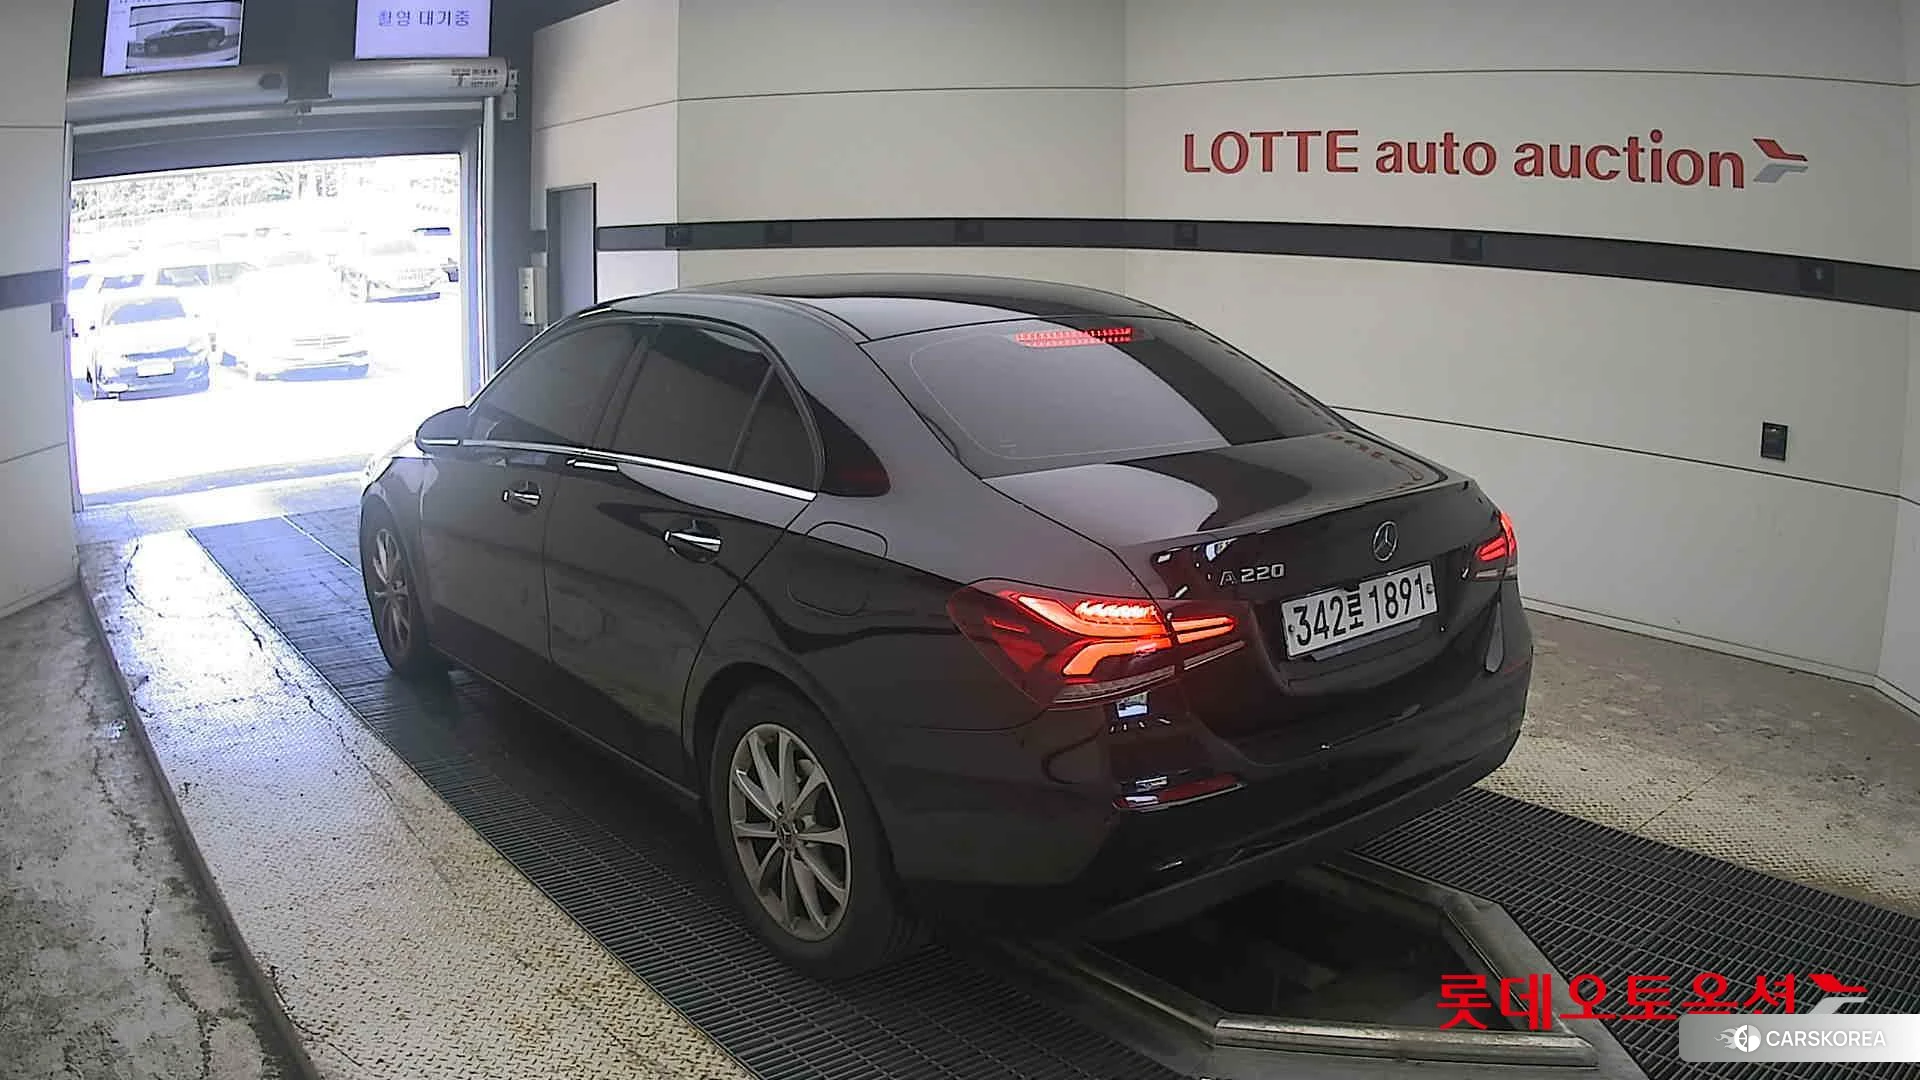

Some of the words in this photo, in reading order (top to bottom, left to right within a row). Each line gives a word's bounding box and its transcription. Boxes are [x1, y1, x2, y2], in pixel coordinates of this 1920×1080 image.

[1183, 130, 1359, 174] LOTTE
[1375, 132, 1497, 176] auto
[1513, 129, 1745, 189] auction
[1219, 570, 1236, 586] A
[1240, 563, 1285, 582] 220
